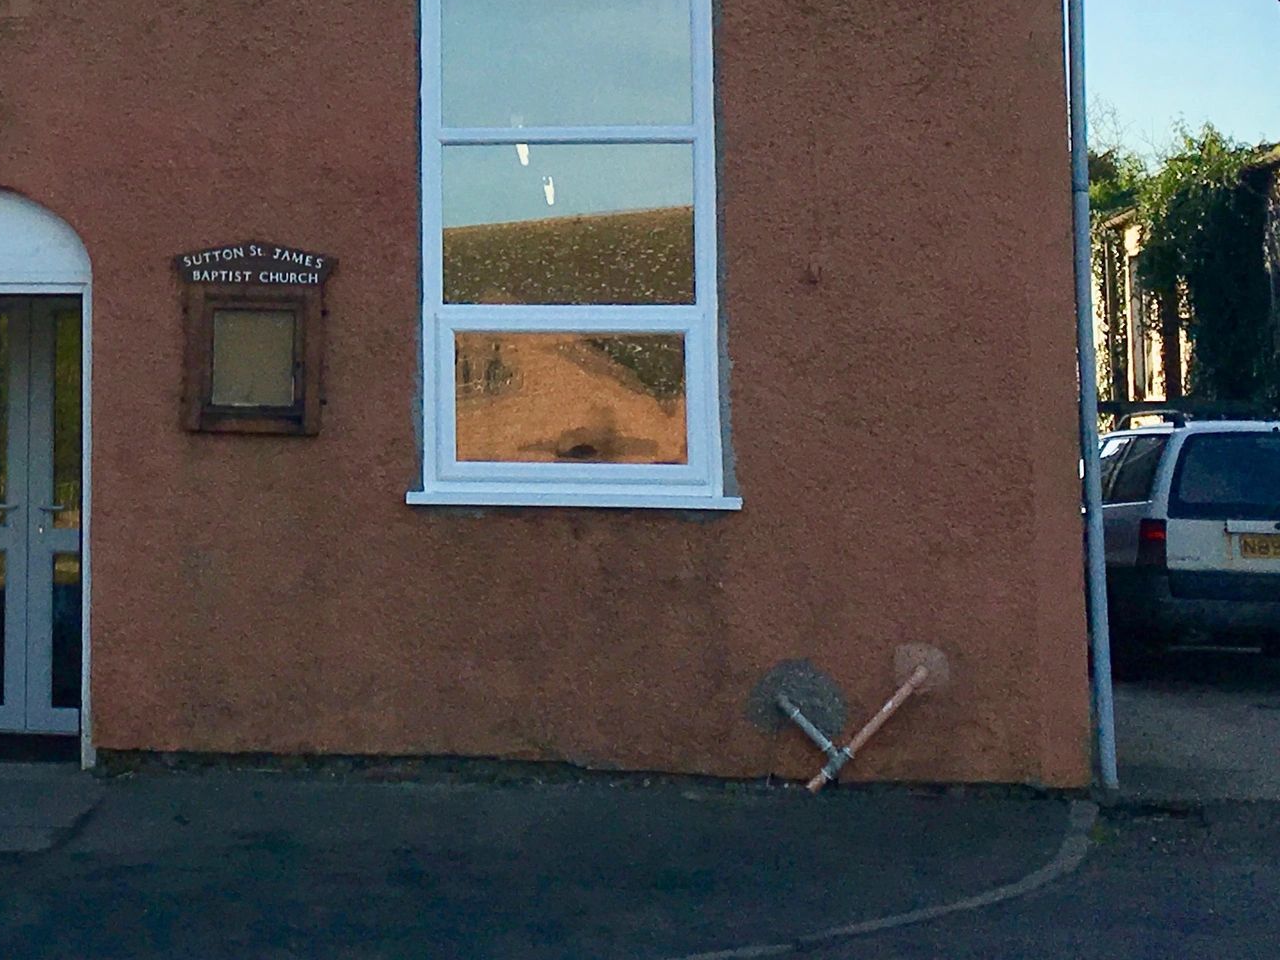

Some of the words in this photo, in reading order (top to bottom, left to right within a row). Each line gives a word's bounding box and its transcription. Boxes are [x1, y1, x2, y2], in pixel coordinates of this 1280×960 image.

[183, 247, 245, 267] SUTTON
[273, 248, 324, 269] JAMES
[193, 270, 252, 282] BAPTIST
[259, 271, 319, 284] CHURCH
